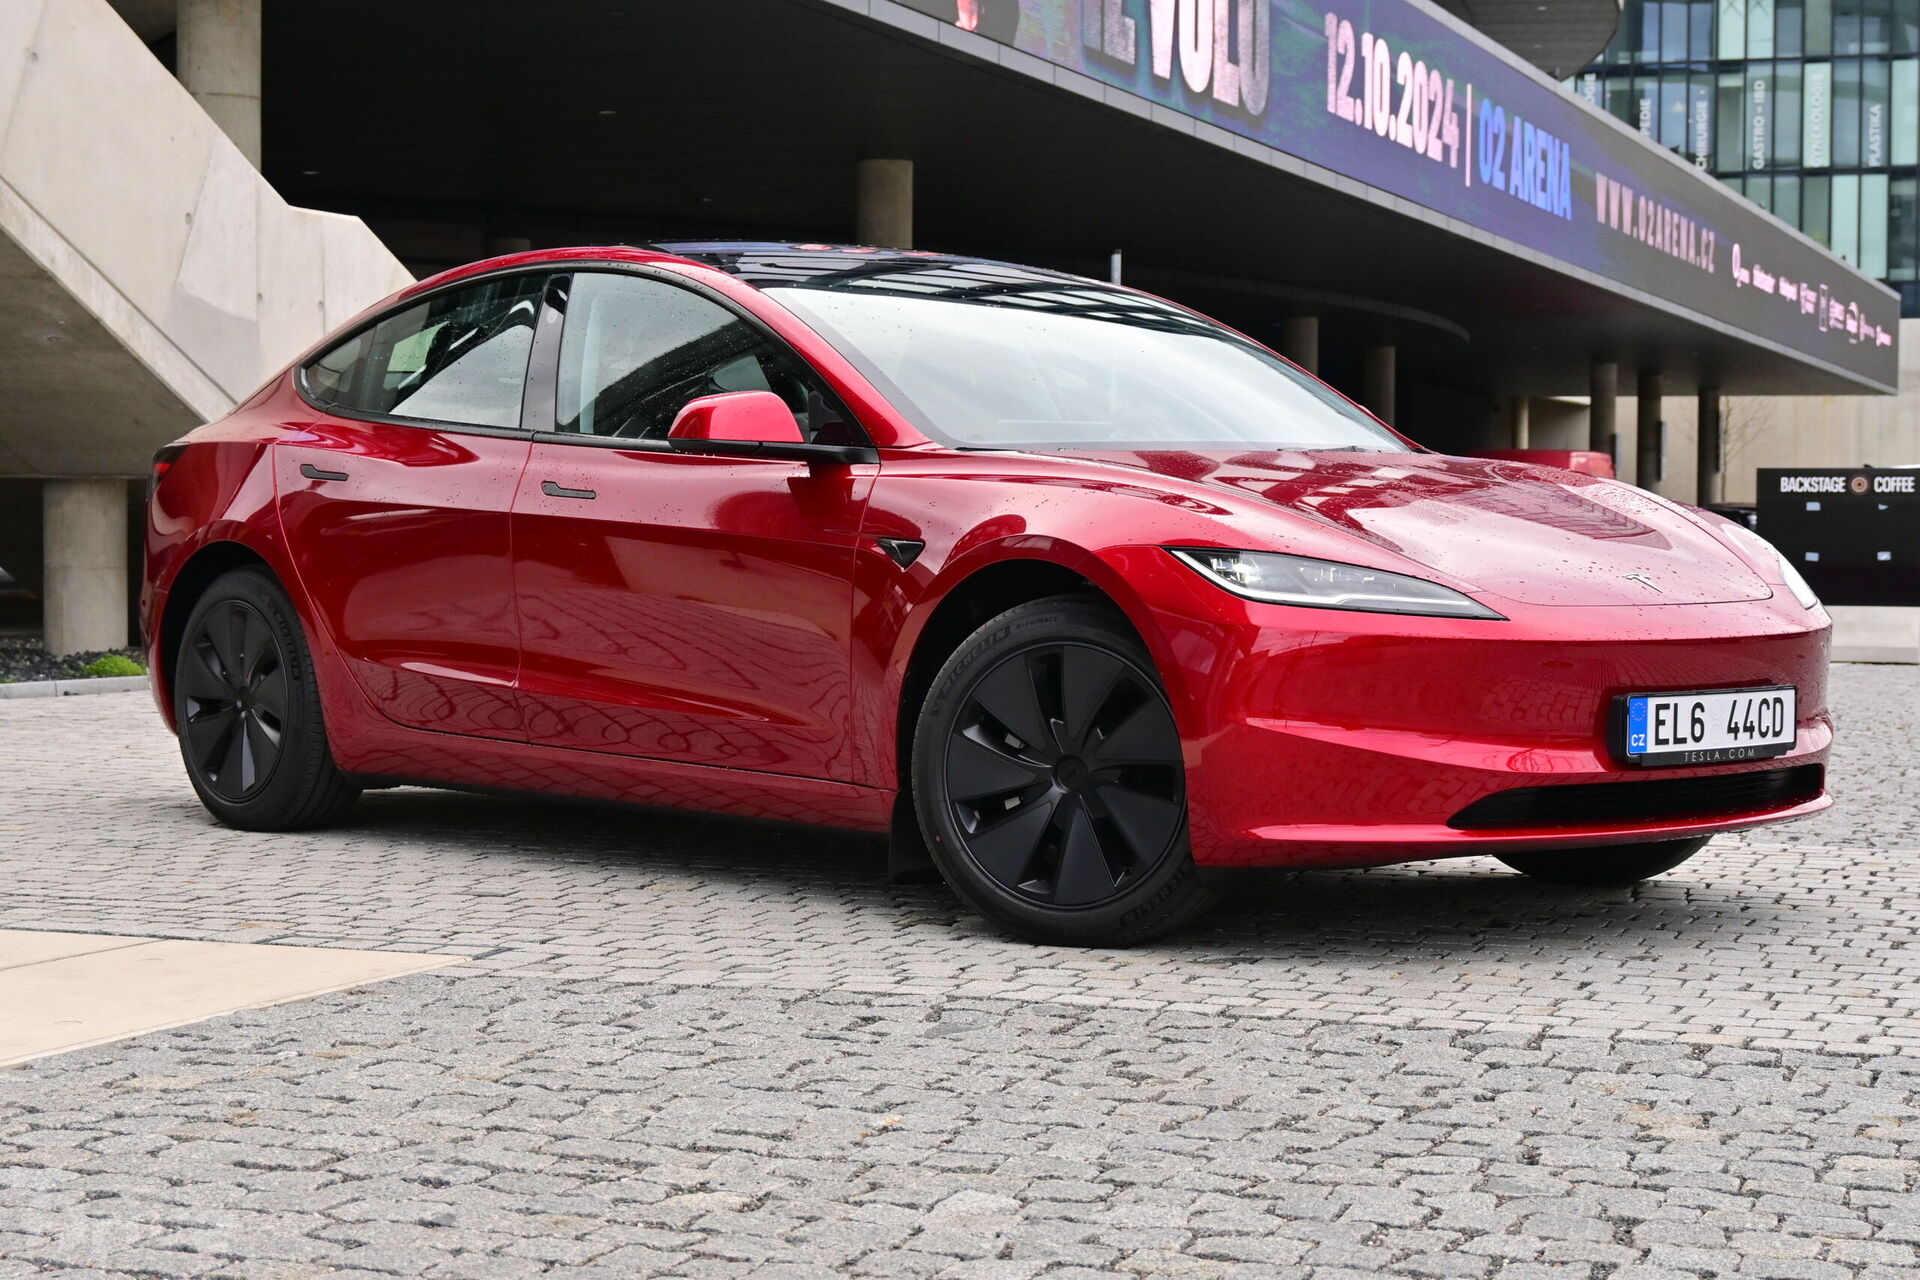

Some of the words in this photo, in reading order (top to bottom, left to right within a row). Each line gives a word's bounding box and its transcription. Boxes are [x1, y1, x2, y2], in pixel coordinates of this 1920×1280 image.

[1325, 12, 1459, 168] 12.10.2024
[1509, 116, 1572, 221] ARENA
[1752, 116, 1765, 170] GASTRO
[1811, 73, 1824, 168] GYNEKOLOGIE
[1869, 104, 1882, 168] PLASTIKA
[1780, 476, 1846, 493] BACKSTAGE
[1873, 476, 1915, 493] COFFEE
[1631, 734, 1645, 746] CZ
[1655, 702, 1705, 745] EL6
[1727, 697, 1784, 740] 44CD
[1684, 748, 1755, 762] TESLA.COM
